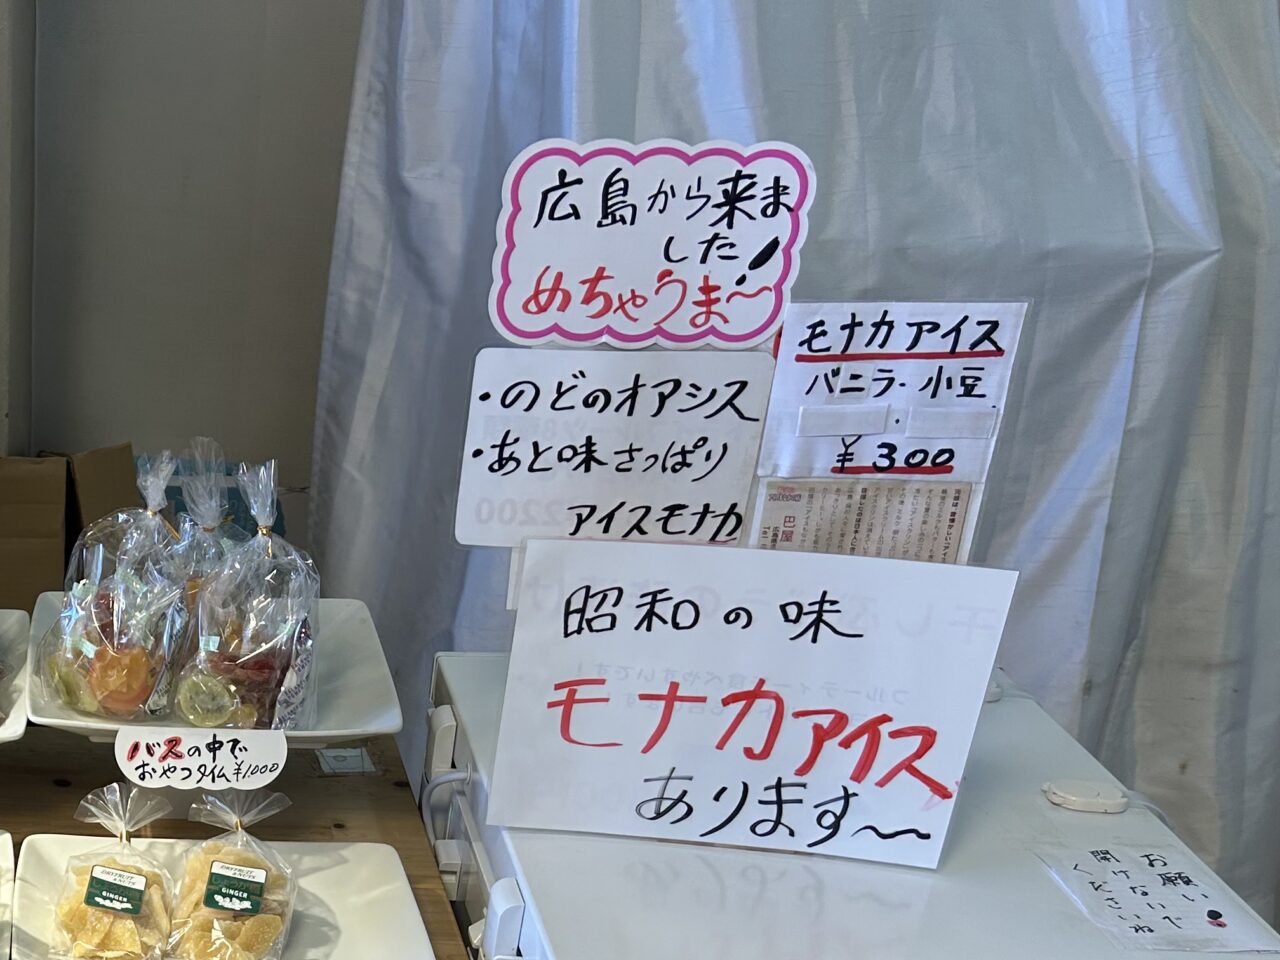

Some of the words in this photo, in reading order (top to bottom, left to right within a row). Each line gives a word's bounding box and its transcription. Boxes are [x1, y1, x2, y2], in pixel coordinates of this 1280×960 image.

[532, 168, 796, 229] 広島から来ま
[800, 311, 1005, 355] モナカアイス
[836, 436, 955, 472] ¥300
[567, 501, 744, 543] アイスモナカ
[562, 584, 865, 644] 昭和の味
[127, 734, 248, 763] バスの中で
[547, 677, 953, 800] モナカアイス
[101, 890, 128, 902] GINGER
[221, 887, 248, 898] GINGER
[1089, 850, 1183, 930] 開けないで
